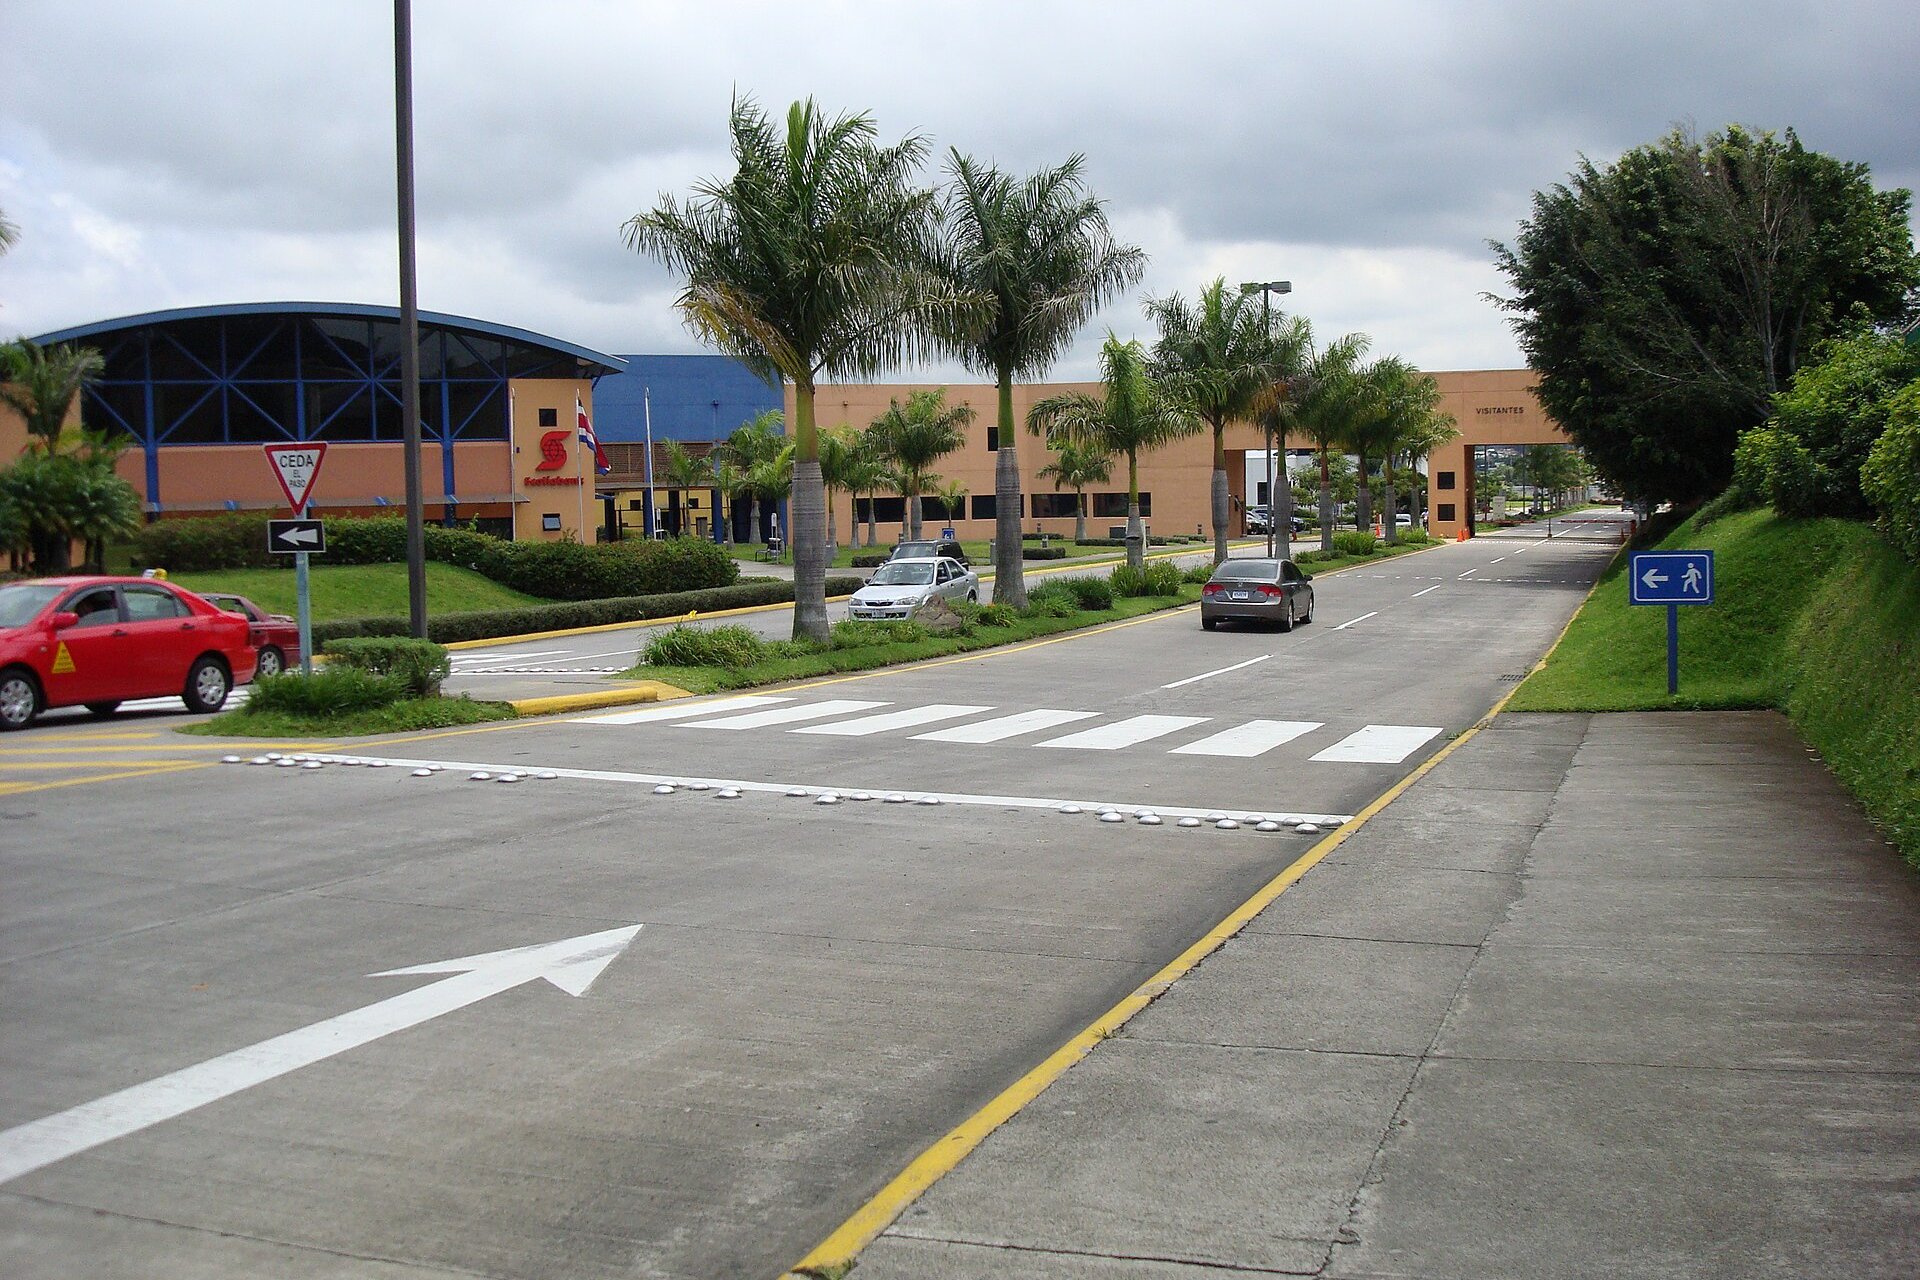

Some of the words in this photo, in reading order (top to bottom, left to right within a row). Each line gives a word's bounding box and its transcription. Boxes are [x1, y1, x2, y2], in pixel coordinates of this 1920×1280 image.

[1475, 406, 1525, 415] VISITANTES
[279, 454, 315, 468] CEDA
[293, 469, 301, 478] EL
